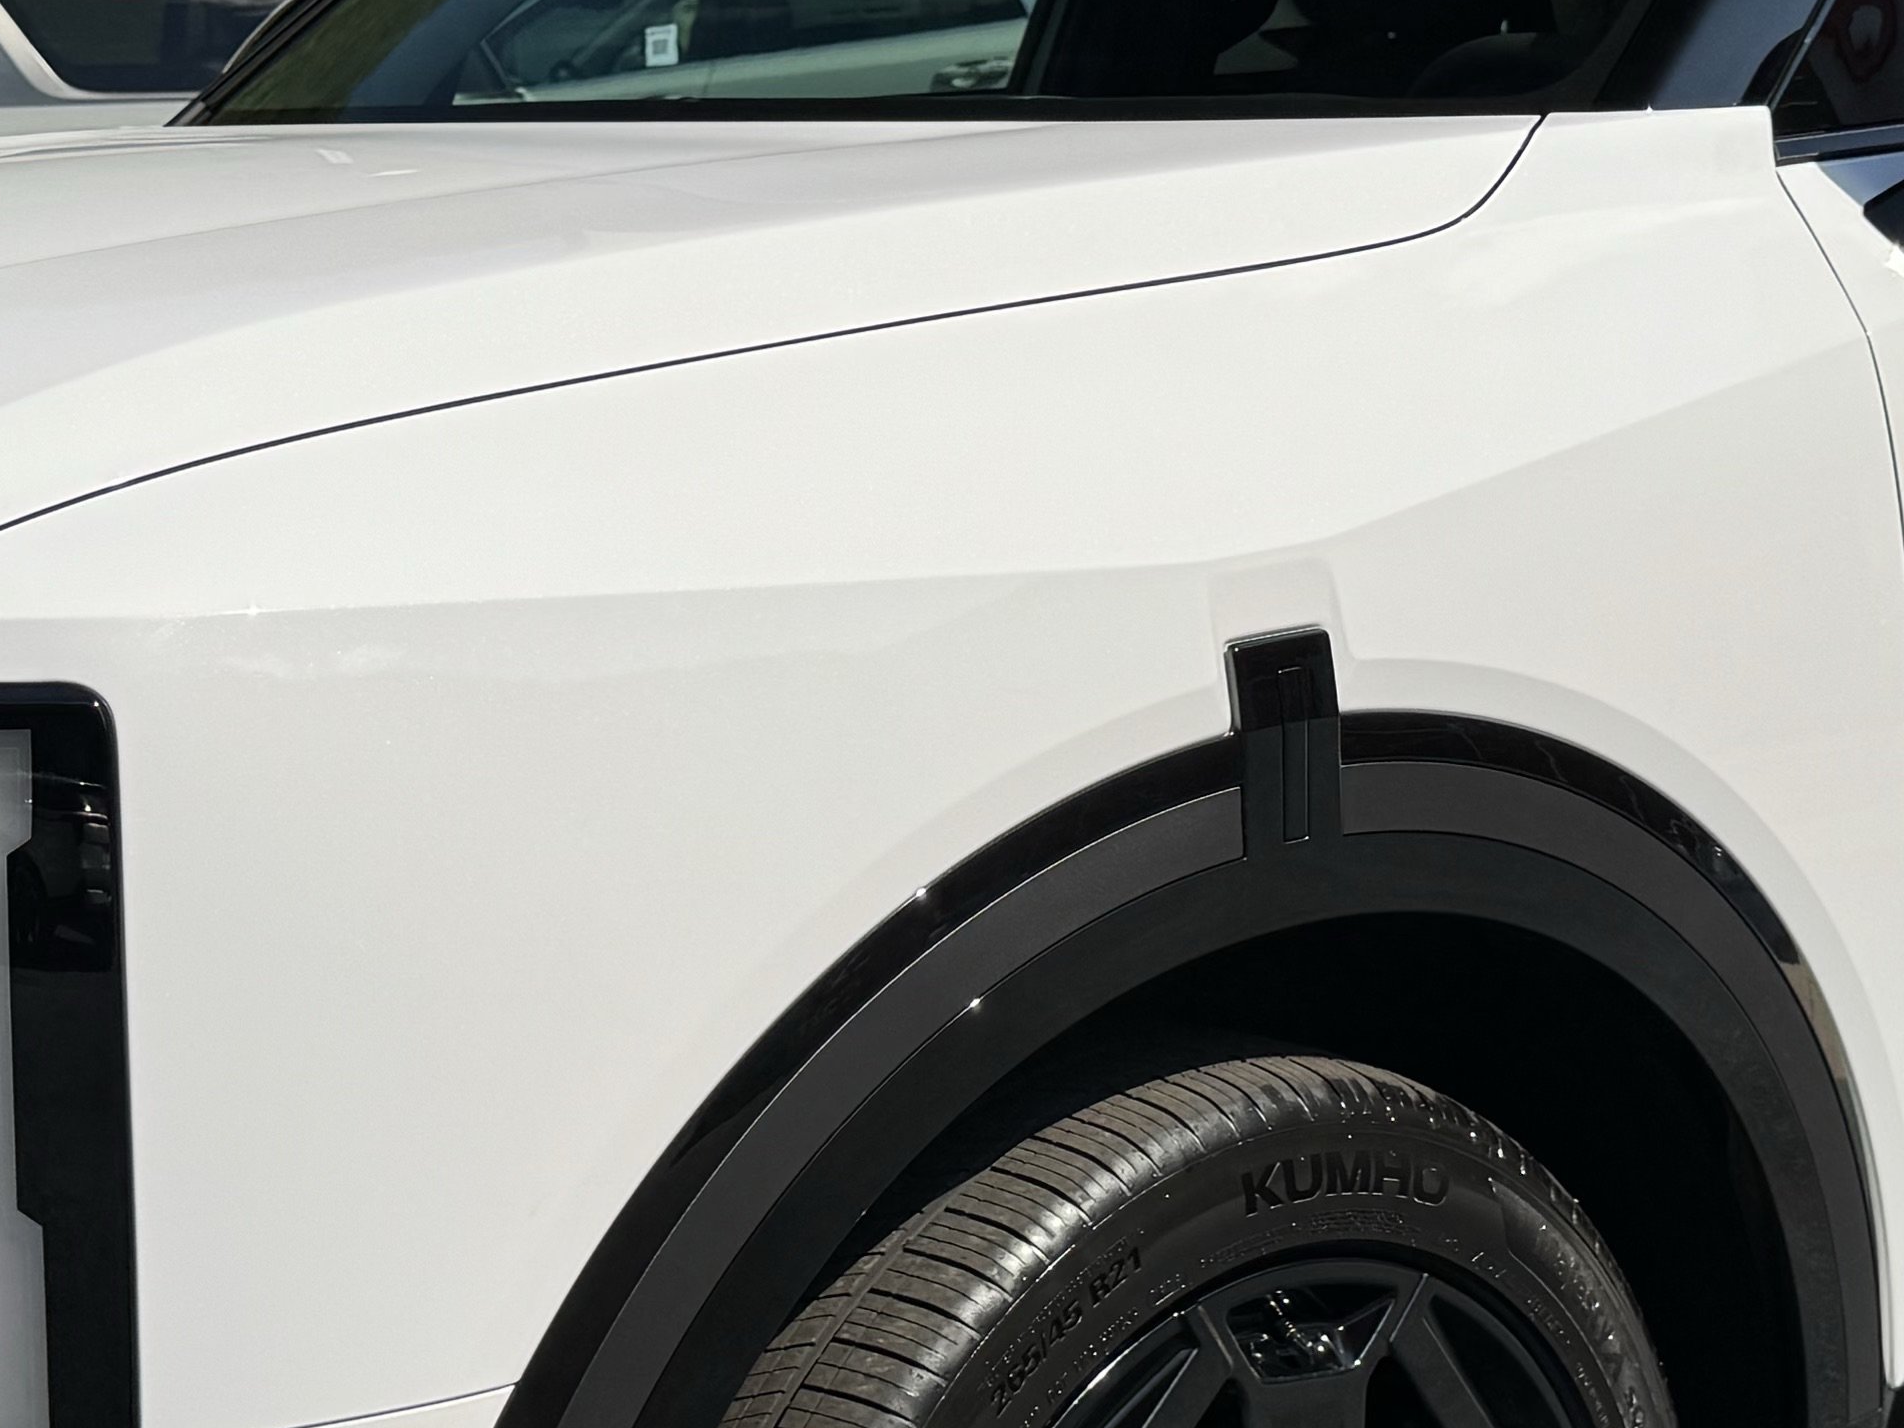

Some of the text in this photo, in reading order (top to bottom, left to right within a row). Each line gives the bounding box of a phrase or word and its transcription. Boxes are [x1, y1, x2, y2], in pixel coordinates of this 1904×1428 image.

[1240, 1150, 1450, 1218] KUMHO
[989, 1295, 1085, 1420] 265/45
[1087, 1243, 1143, 1309] R21
